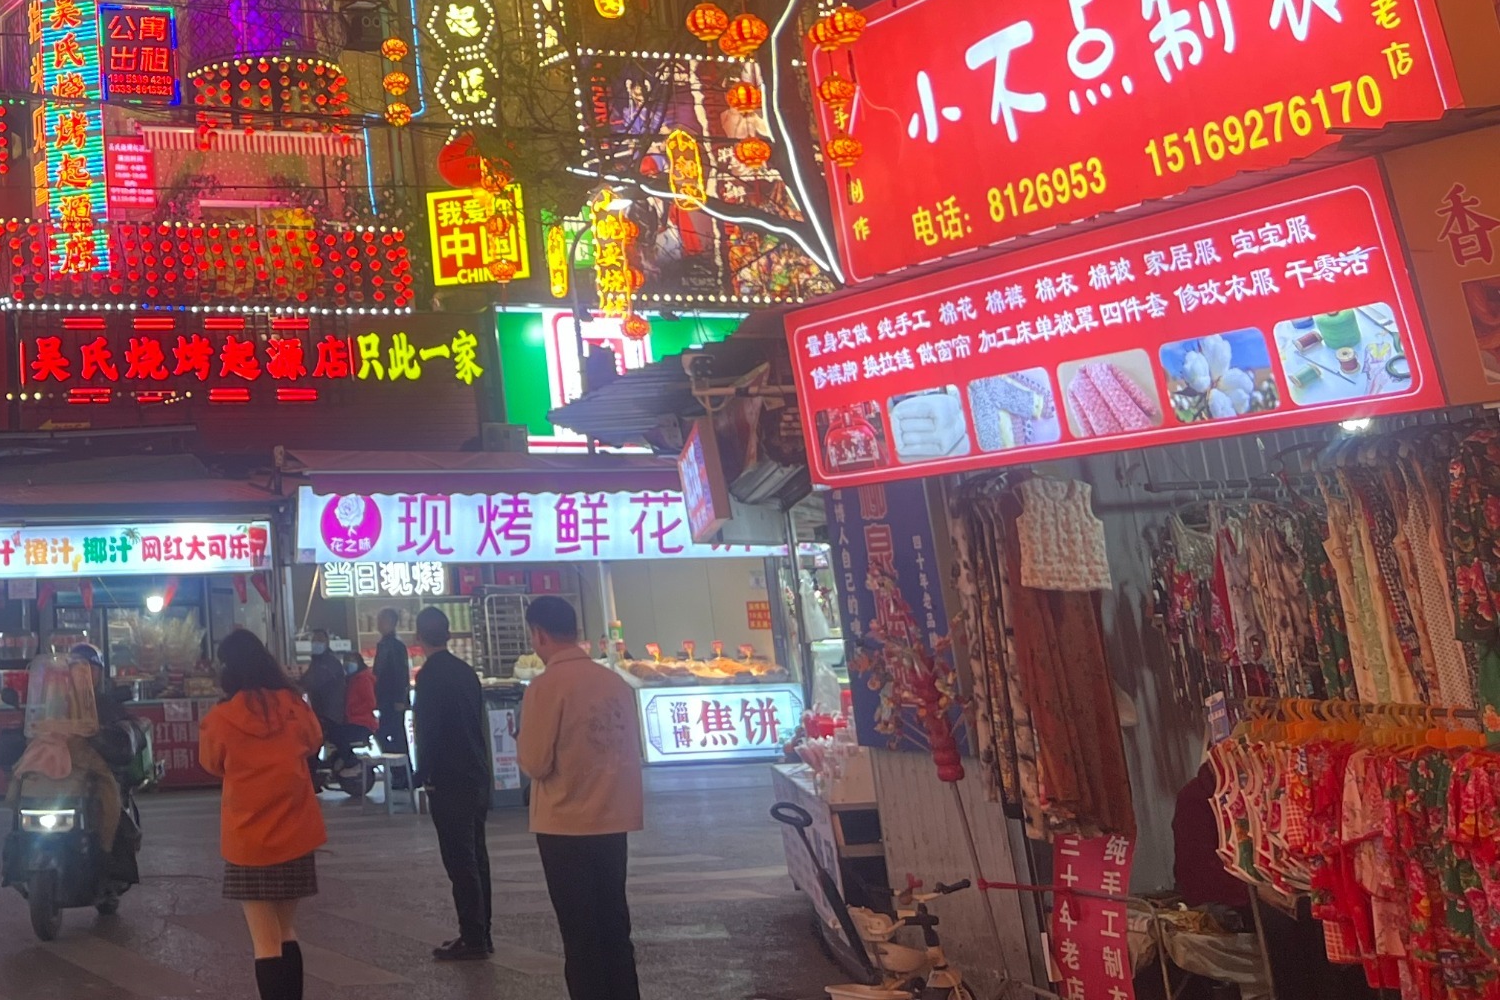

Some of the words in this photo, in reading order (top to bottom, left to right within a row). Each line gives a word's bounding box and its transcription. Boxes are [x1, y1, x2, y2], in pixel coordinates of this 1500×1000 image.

[109, 15, 167, 41] 公寓
[110, 47, 169, 73] 出租
[1143, 75, 1383, 178] 15169276170
[987, 158, 1107, 224] 8126953
[440, 227, 519, 268] 中国
[1435, 182, 1500, 266] 香
[456, 267, 512, 285] CHIN
[805, 323, 872, 357] 量身定做
[877, 310, 931, 340] 纯手工
[938, 296, 977, 325] 棉花
[985, 284, 1026, 314] 棉裤
[1035, 272, 1078, 303] 棉衣
[1088, 258, 1135, 290] 棉被
[1144, 237, 1221, 277] 家居服
[1231, 214, 1317, 259] 宝宝服
[810, 360, 859, 390] 修裤脚
[862, 348, 914, 379] 换拉链
[917, 335, 971, 366] 做窗帘
[978, 305, 1098, 354] 加工床单被罩
[1099, 293, 1168, 326] 四件套
[1174, 267, 1280, 313] 修改衣服
[1285, 246, 1370, 288] 干零活
[31, 333, 349, 382] 吴氏烧烤起源店
[357, 329, 483, 385] 只此一家
[24, 538, 74, 565] 橙汁
[83, 536, 132, 564] 椰汁
[141, 533, 251, 562] 网红大可乐
[329, 537, 372, 553] 花之味
[397, 493, 752, 557] 现烤鲜花
[670, 702, 691, 748] 淄博
[697, 697, 781, 747] 焦饼
